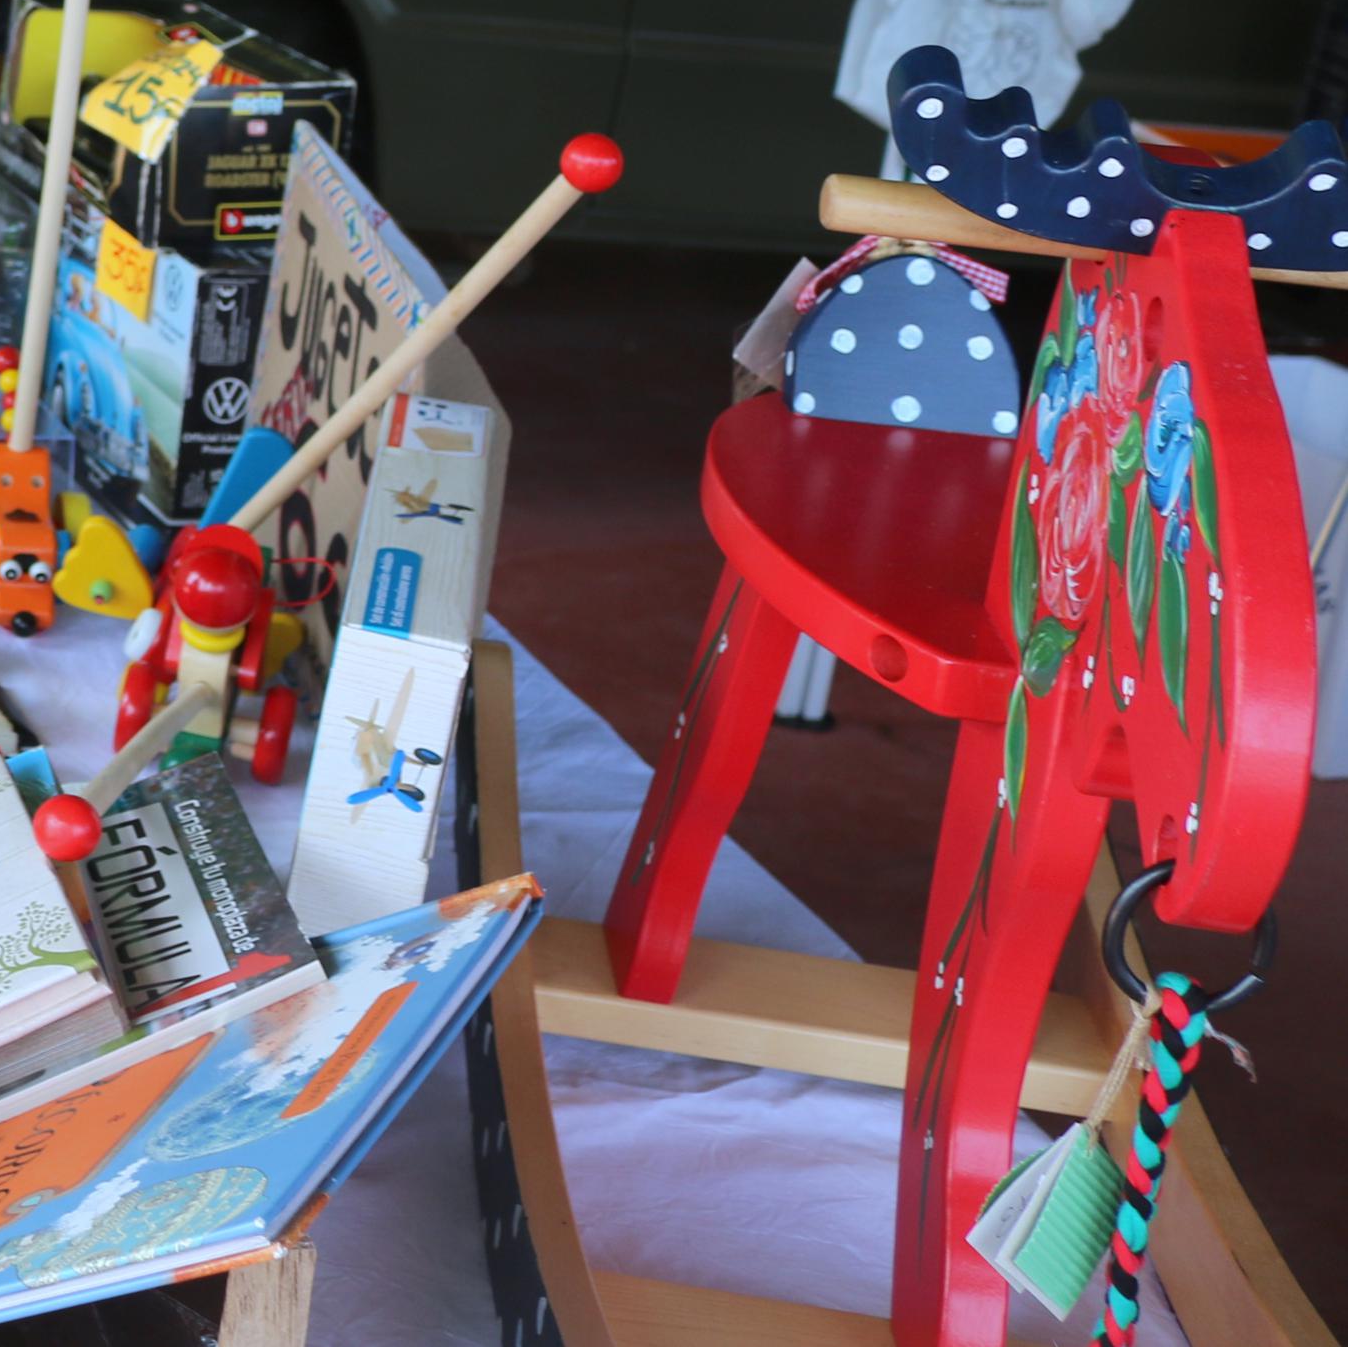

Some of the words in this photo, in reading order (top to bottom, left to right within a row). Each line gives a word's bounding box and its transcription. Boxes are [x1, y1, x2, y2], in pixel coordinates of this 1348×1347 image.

[86, 817, 202, 1012] FÓRMULA
[174, 799, 216, 866] Construye
[207, 875, 250, 942] monoplaza
